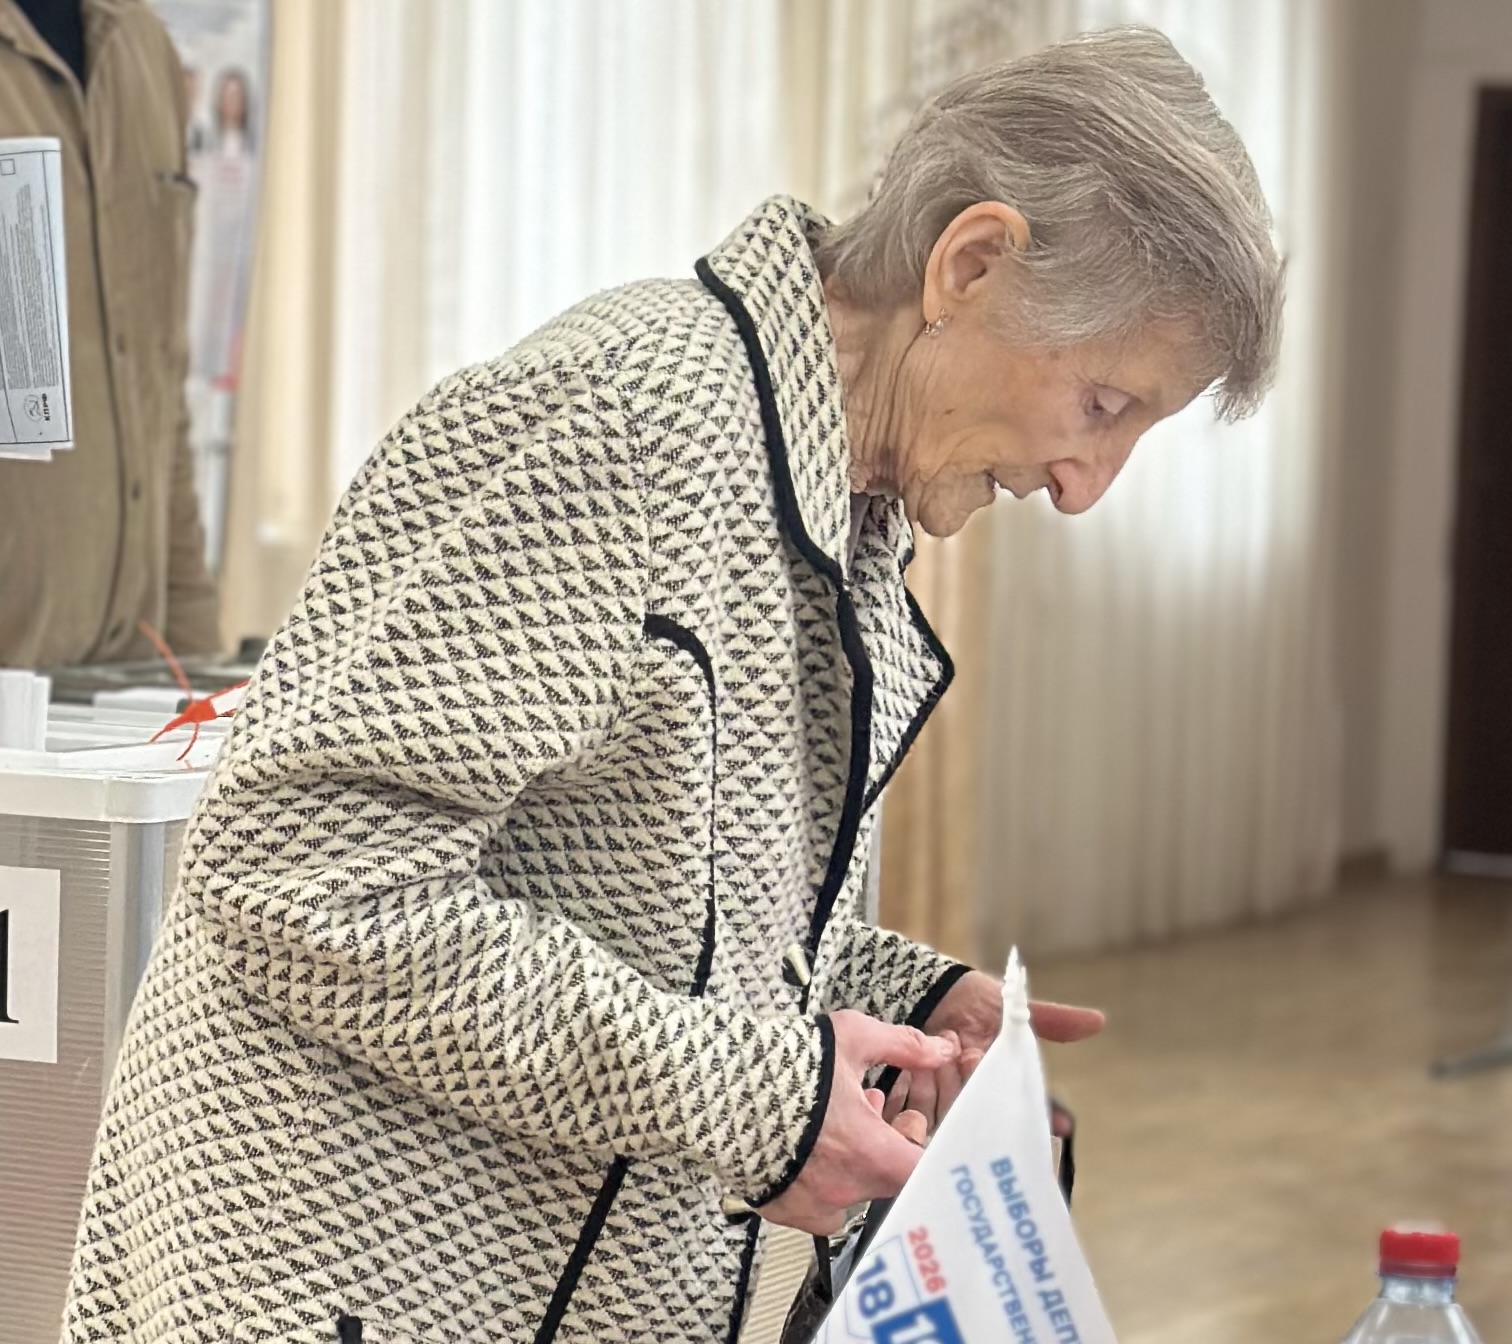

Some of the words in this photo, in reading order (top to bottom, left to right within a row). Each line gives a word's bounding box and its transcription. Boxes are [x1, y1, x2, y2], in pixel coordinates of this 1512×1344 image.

[990, 1156, 1054, 1283] ВЫБОРЫ
[856, 1254, 896, 1320] 18
[908, 1226, 947, 1294] 2026
